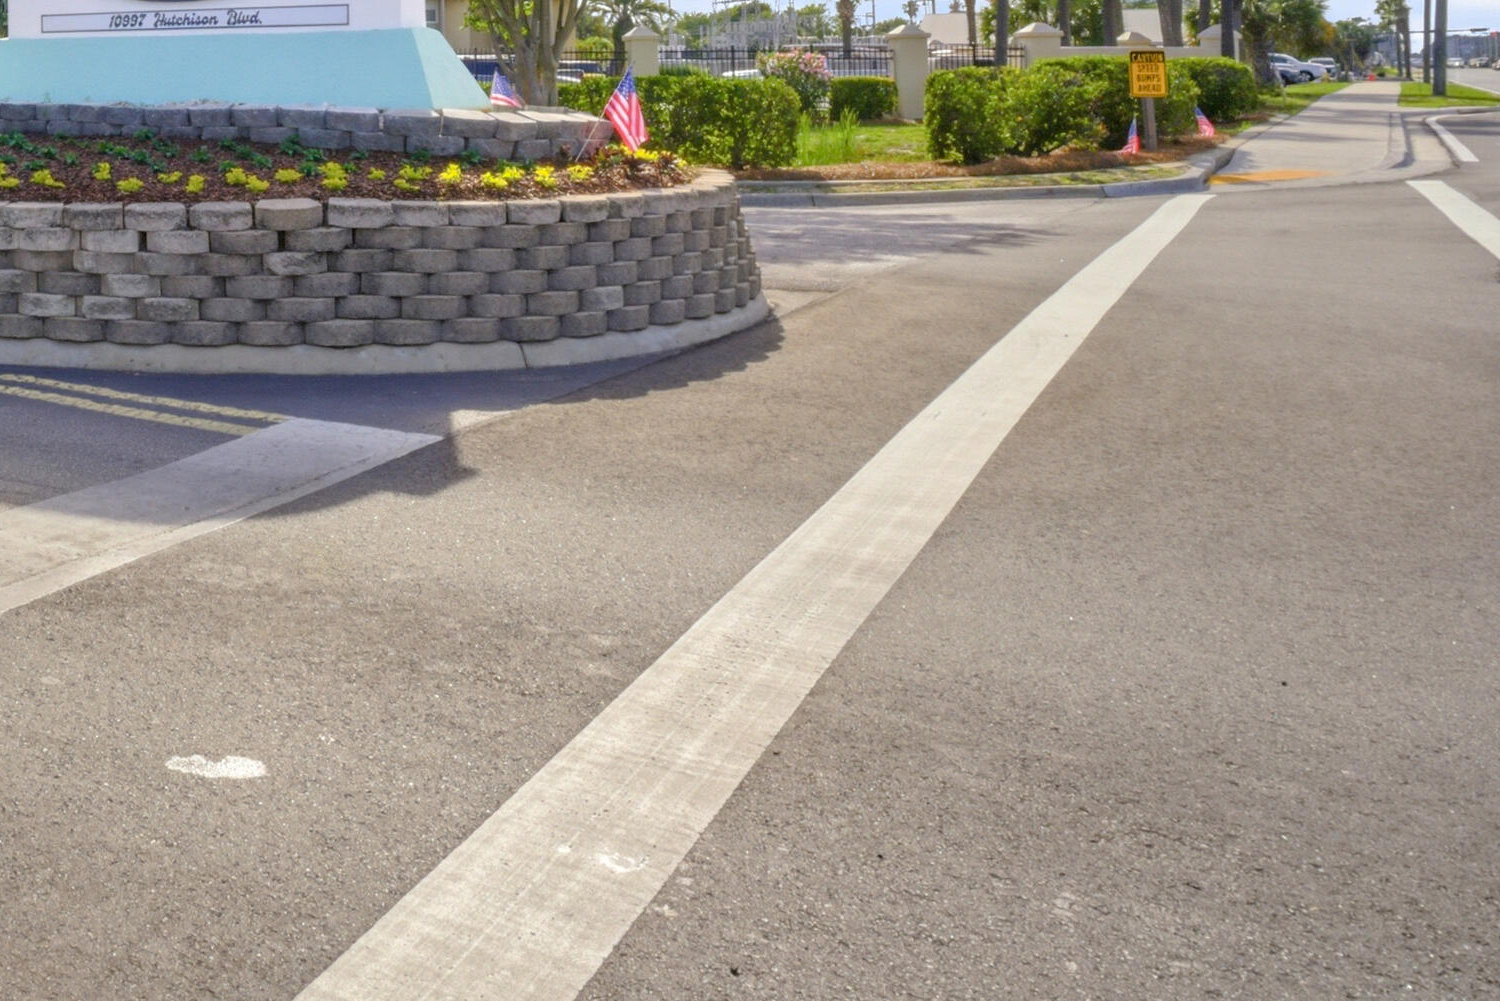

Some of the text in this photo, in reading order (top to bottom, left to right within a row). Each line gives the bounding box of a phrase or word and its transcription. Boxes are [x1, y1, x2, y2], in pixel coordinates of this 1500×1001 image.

[109, 8, 262, 28] 10997 Hutchison Blvd.
[1131, 53, 1163, 62] CAUTION
[1137, 63, 1159, 72] SPEED
[1137, 73, 1160, 82] BUMPS
[1138, 83, 1162, 92] AHEAD
